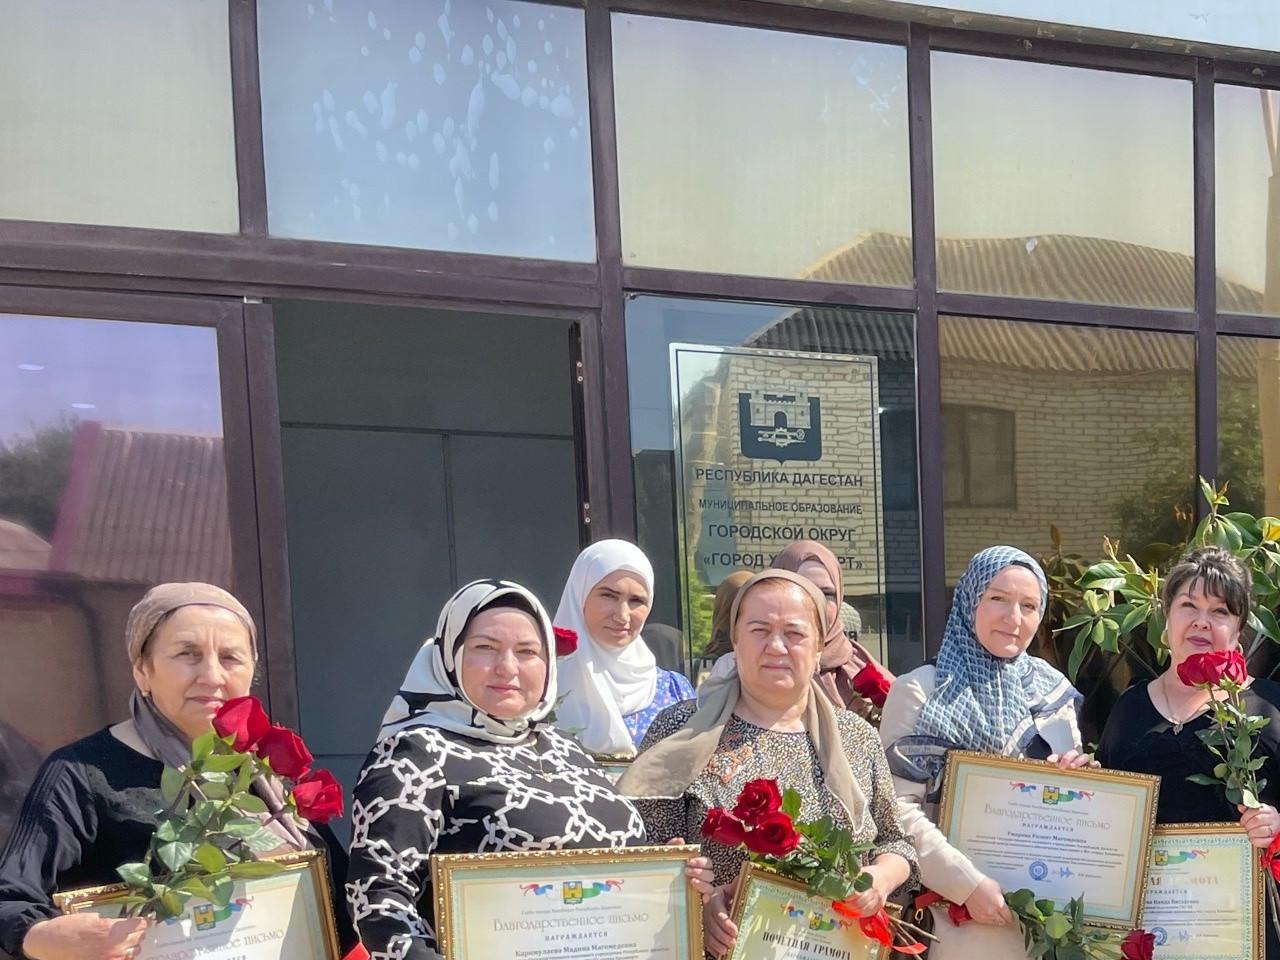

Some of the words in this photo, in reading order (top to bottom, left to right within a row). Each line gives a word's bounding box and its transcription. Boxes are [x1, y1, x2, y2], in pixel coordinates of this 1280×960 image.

[696, 468, 789, 484] РЕСПУБЛИКА
[792, 473, 863, 487] ДАГЕСТАН
[699, 499, 789, 512] МУНИЦИПАЛЬНОЕ
[791, 503, 863, 514] ОБРАЗОВАНИЕ
[808, 527, 857, 542] ОКРУГ
[703, 552, 765, 569] «ГОРОД
[493, 916, 605, 932] Благодарственное
[608, 913, 649, 925] письмо
[244, 929, 285, 947] письмо
[544, 931, 608, 941] НАГРАЖДАЕТСЯ
